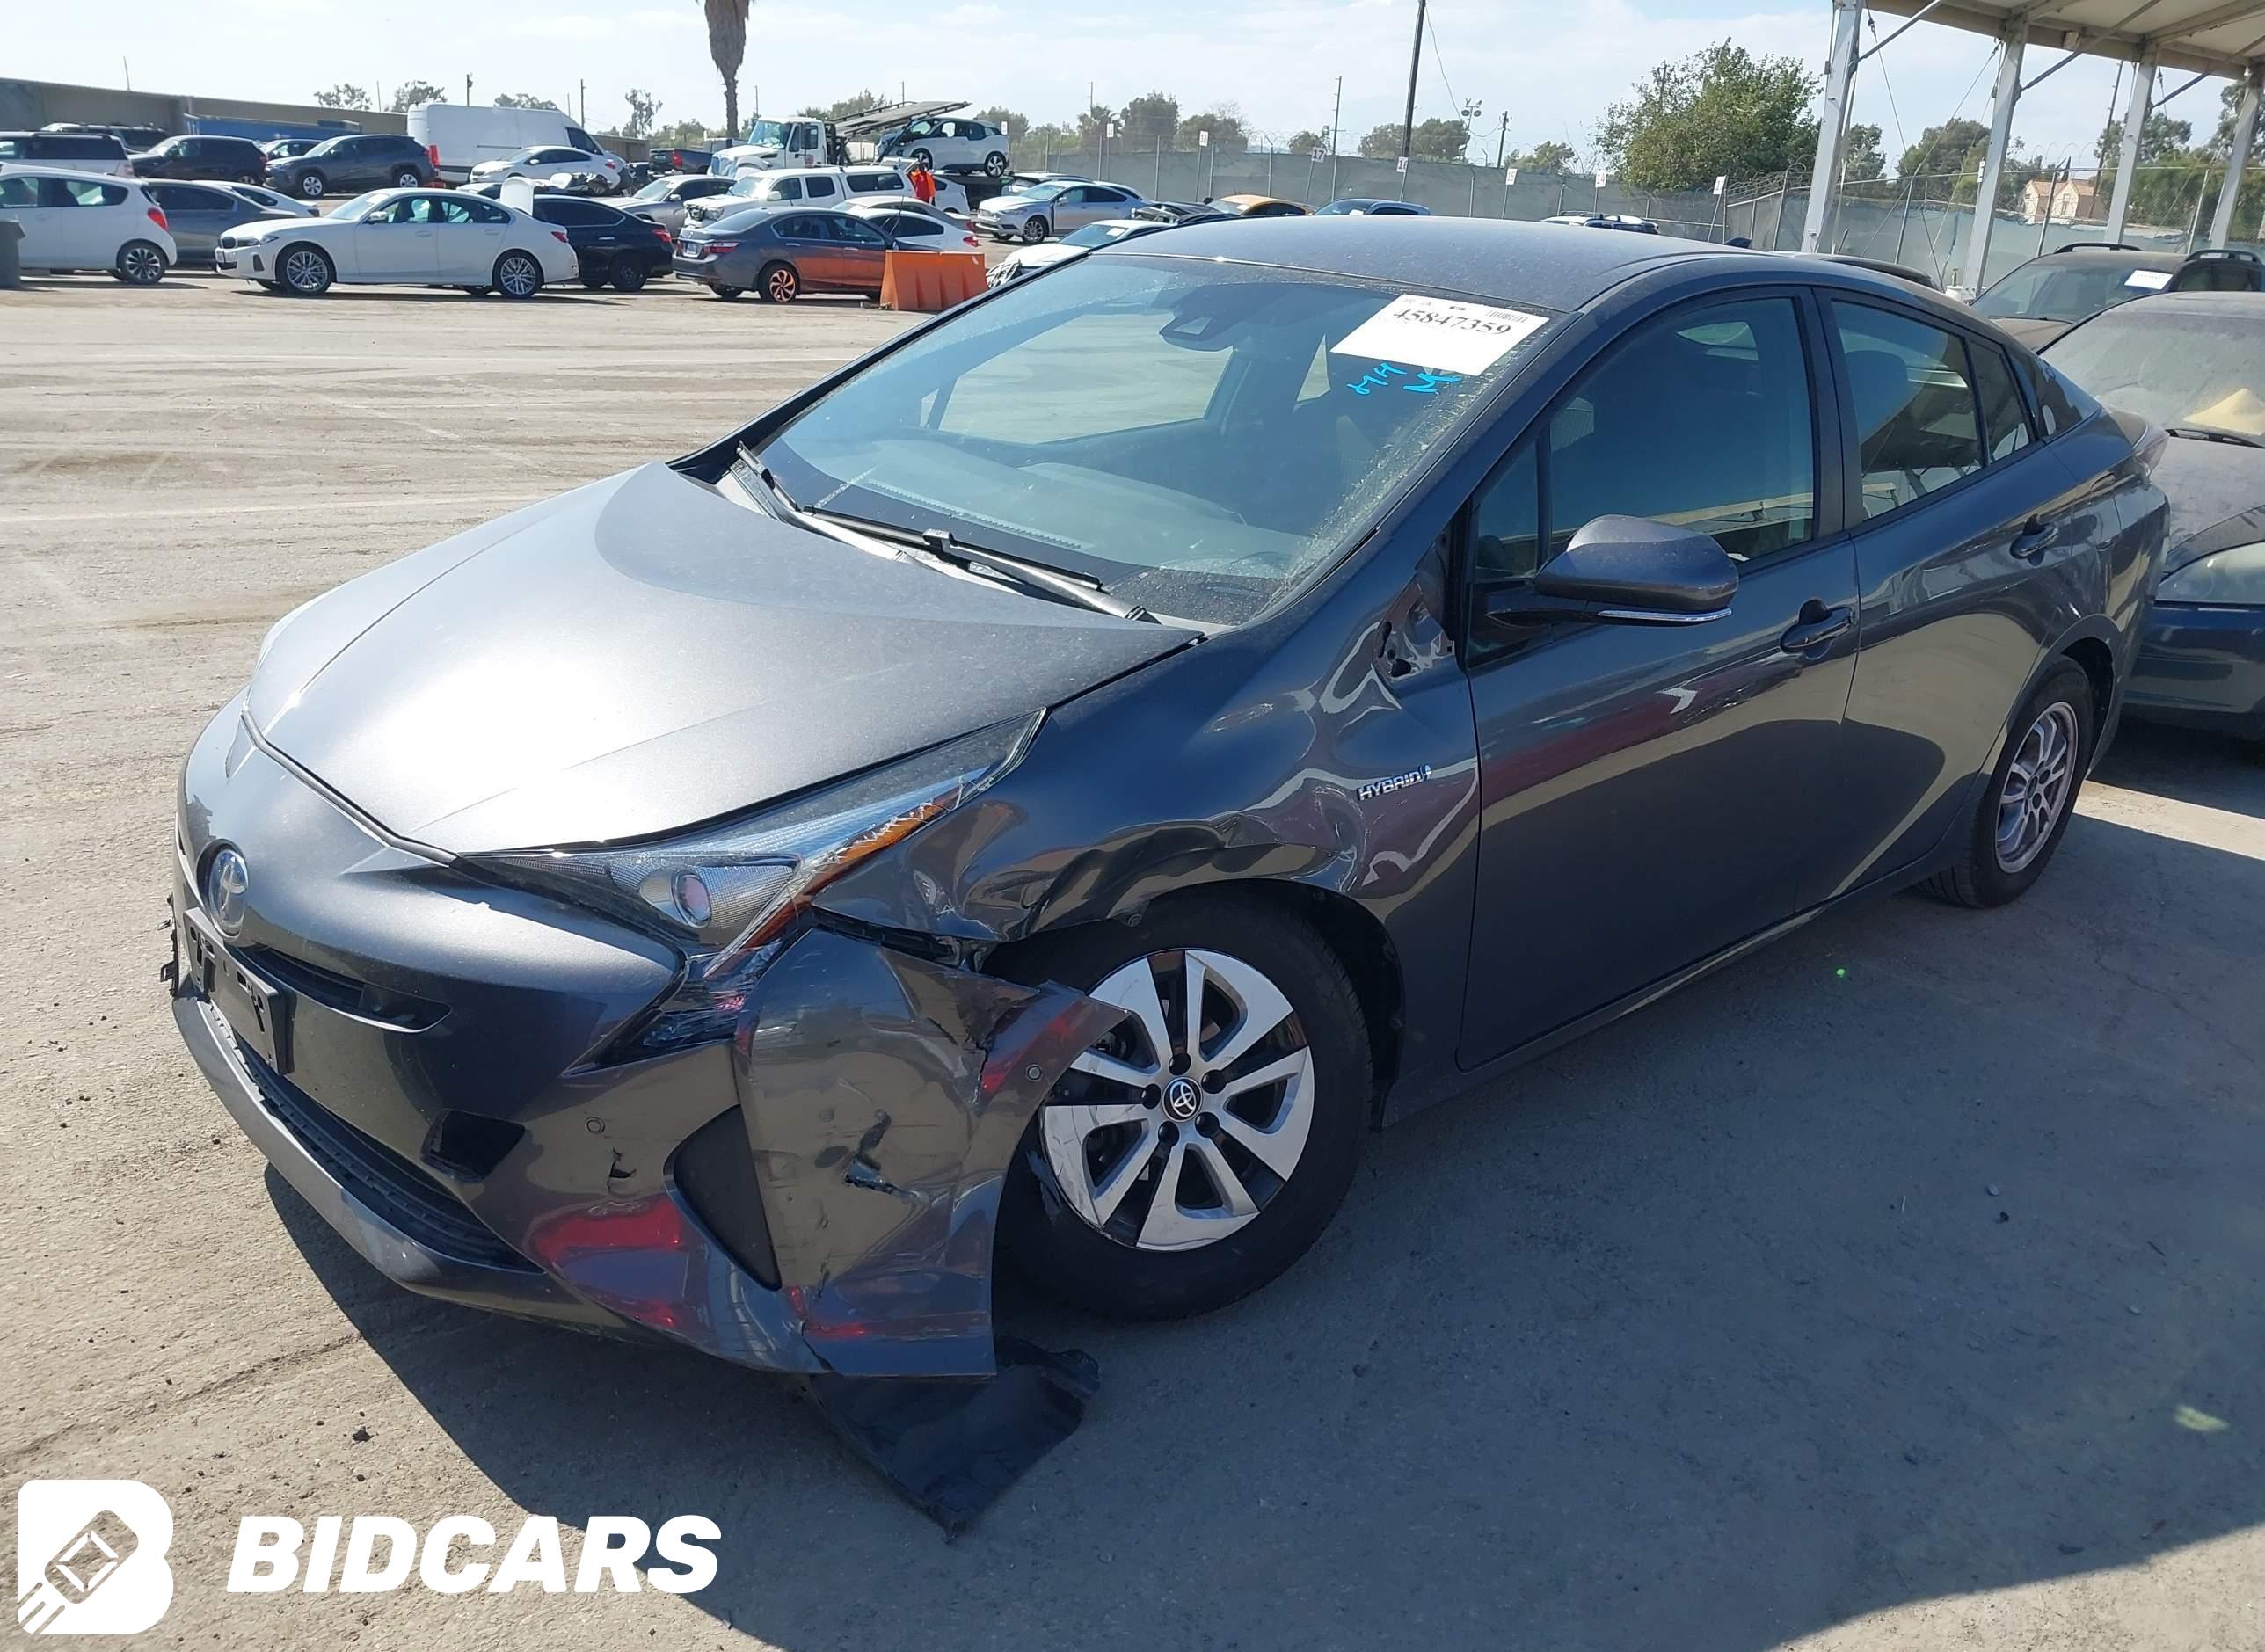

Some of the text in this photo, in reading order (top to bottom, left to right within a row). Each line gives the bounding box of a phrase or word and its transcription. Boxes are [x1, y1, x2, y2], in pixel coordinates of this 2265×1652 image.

[1313, 149, 1324, 160] 17
[1392, 309, 1511, 335] 45847359
[1357, 770, 1423, 801] HYBRID
